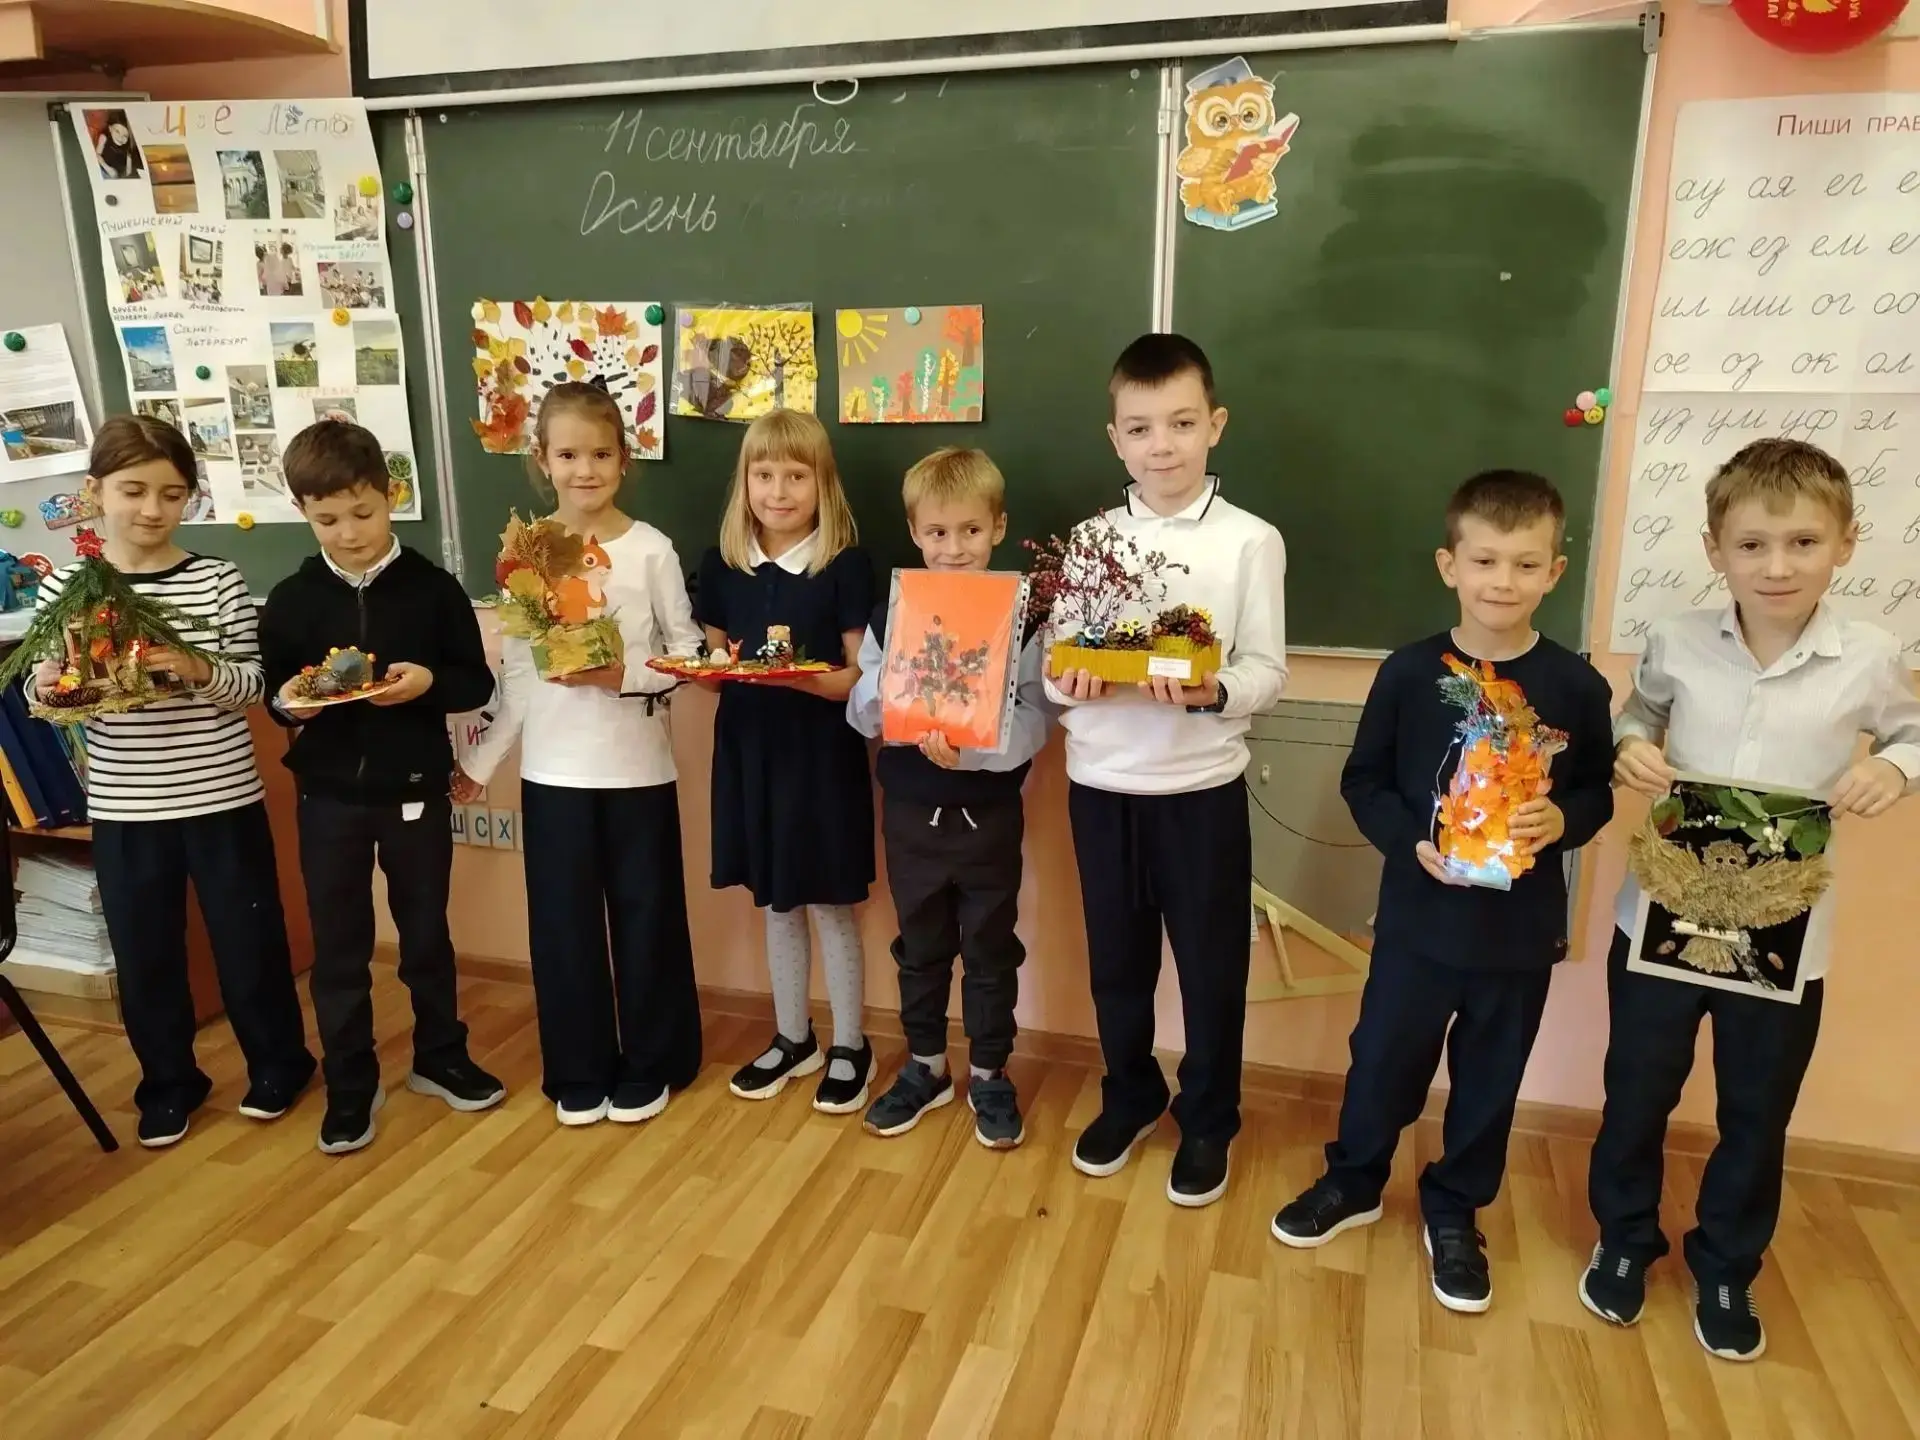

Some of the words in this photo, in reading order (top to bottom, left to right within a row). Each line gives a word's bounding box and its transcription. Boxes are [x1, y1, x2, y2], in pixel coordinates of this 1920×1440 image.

[604, 108, 643, 154] 11
[645, 103, 863, 169] сентября
[580, 170, 717, 236] Осень
[1675, 176, 1725, 219] ау
[1748, 175, 1796, 198] ая
[1669, 236, 1735, 260] еж
[1749, 236, 1790, 276] ез
[1811, 232, 1869, 256] ем
[1811, 293, 1856, 315] ог
[1653, 352, 1690, 374] ое
[1721, 352, 1763, 392] оз
[1791, 352, 1840, 374] ок
[1643, 408, 1694, 445] уз
[1701, 408, 1768, 445] ум
[1778, 409, 1838, 442] уф
[1633, 514, 1674, 551] сд
